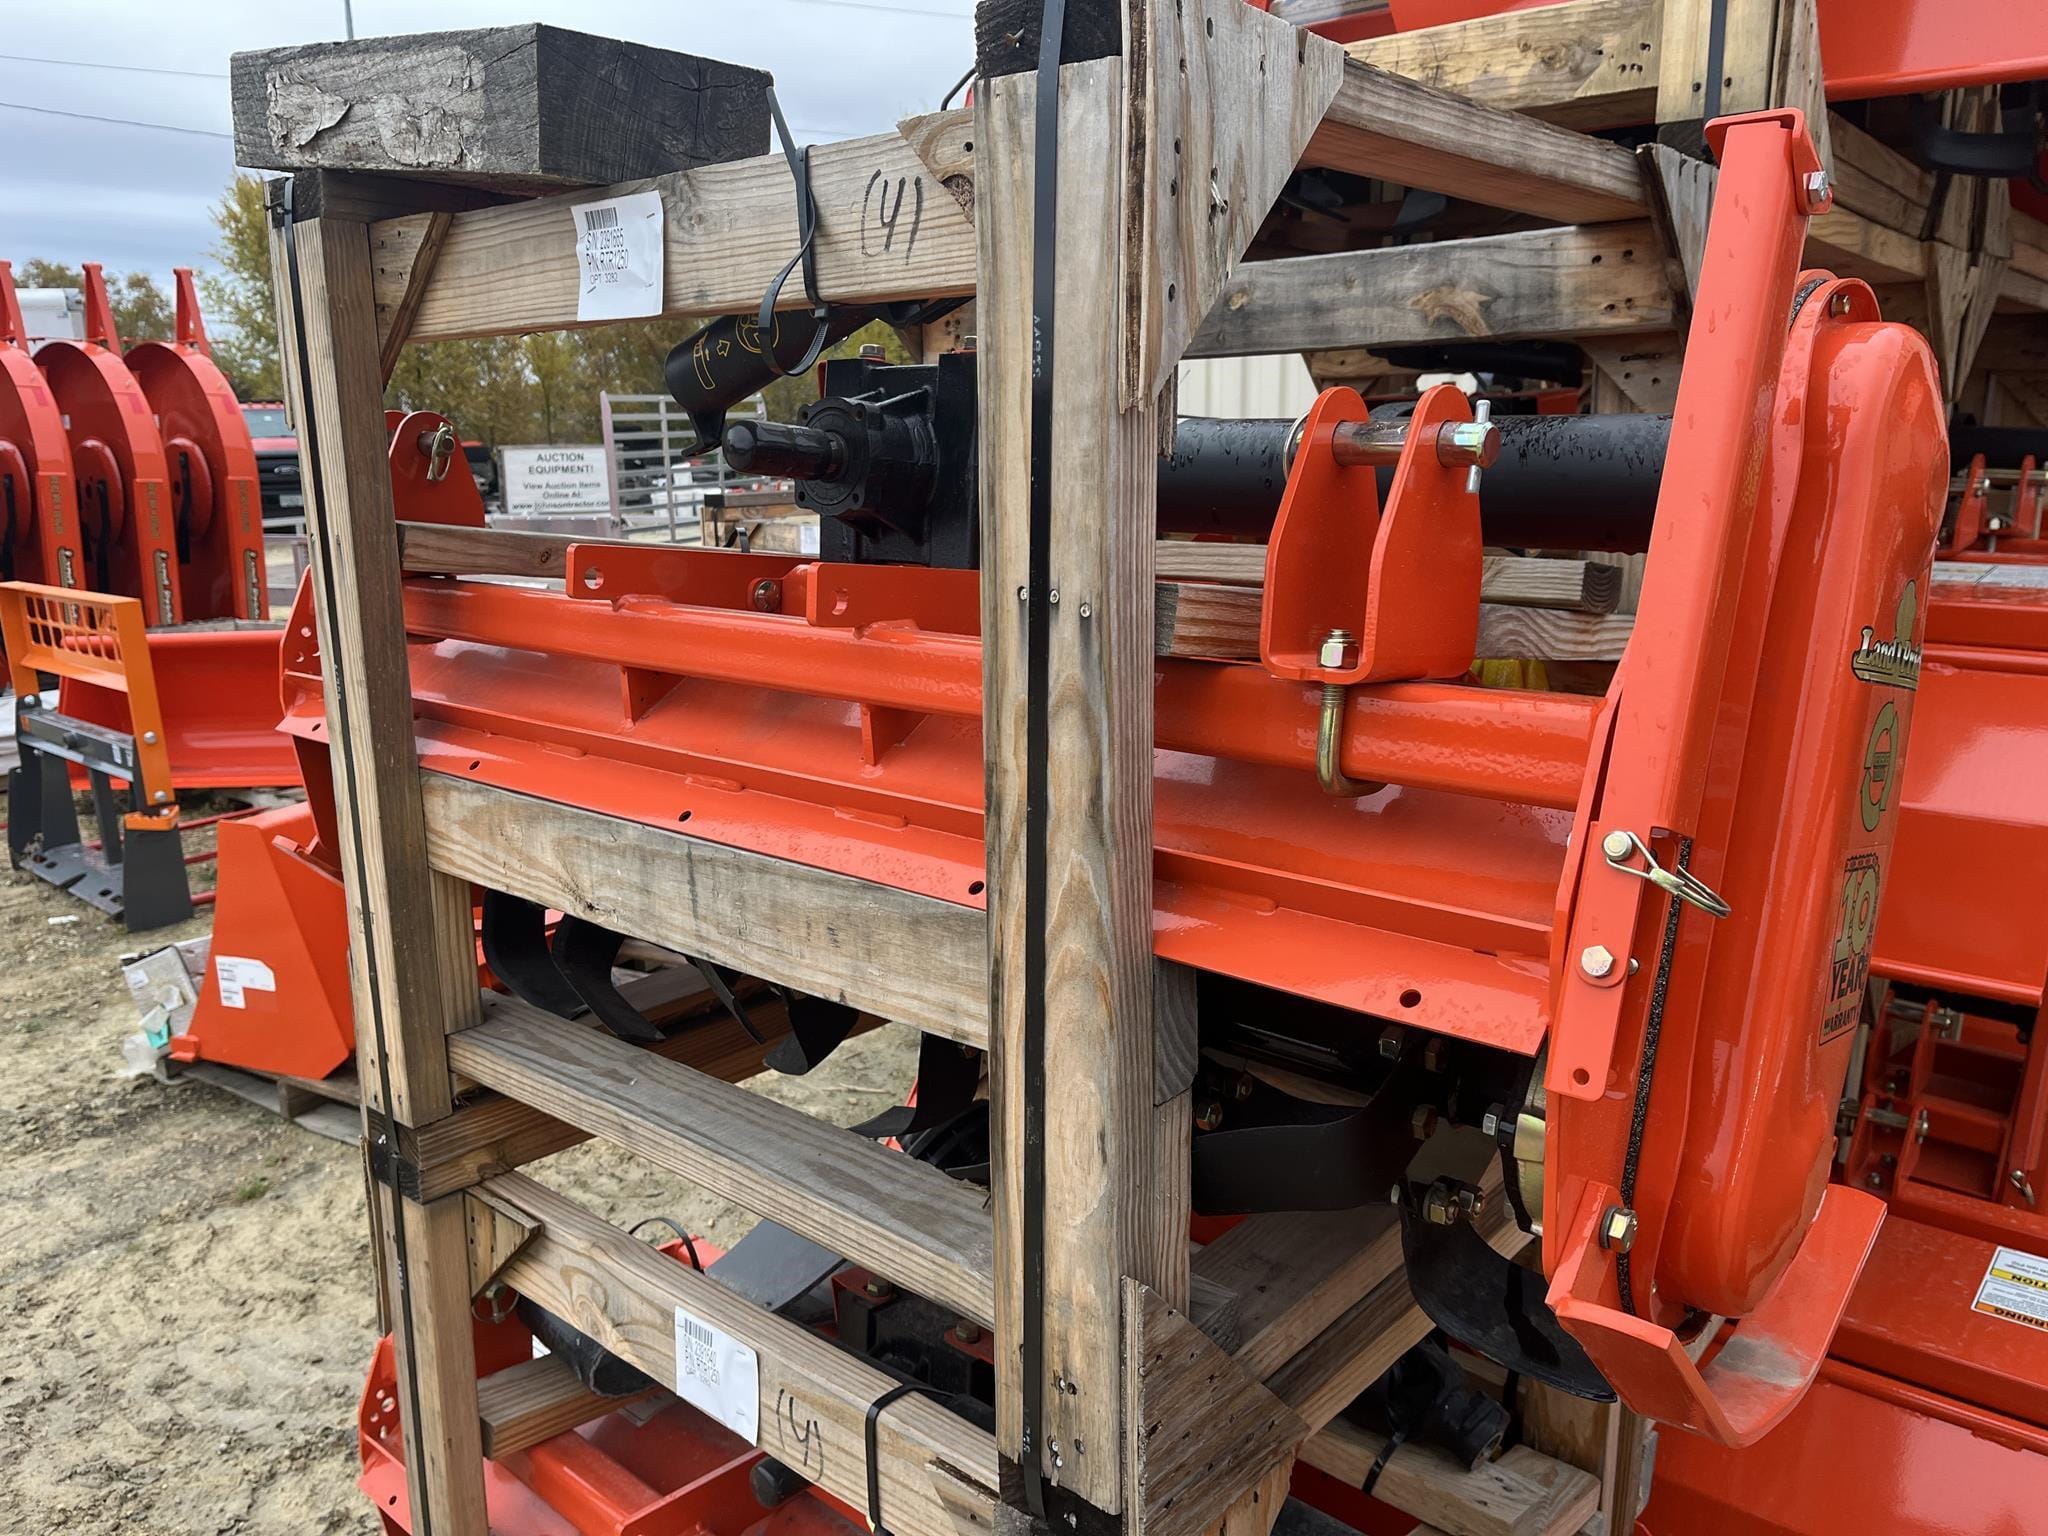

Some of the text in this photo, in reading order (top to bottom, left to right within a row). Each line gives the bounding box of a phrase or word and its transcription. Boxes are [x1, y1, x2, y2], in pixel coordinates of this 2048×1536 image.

[600, 248, 629, 272] RTR1250
[536, 452, 585, 462] AUCTION
[528, 464, 594, 475] EQUIPMENT!
[523, 480, 601, 490] View Auction Items
[542, 490, 570, 500] Online
[1856, 628, 1896, 671] Land
[1834, 868, 1877, 963] 10
